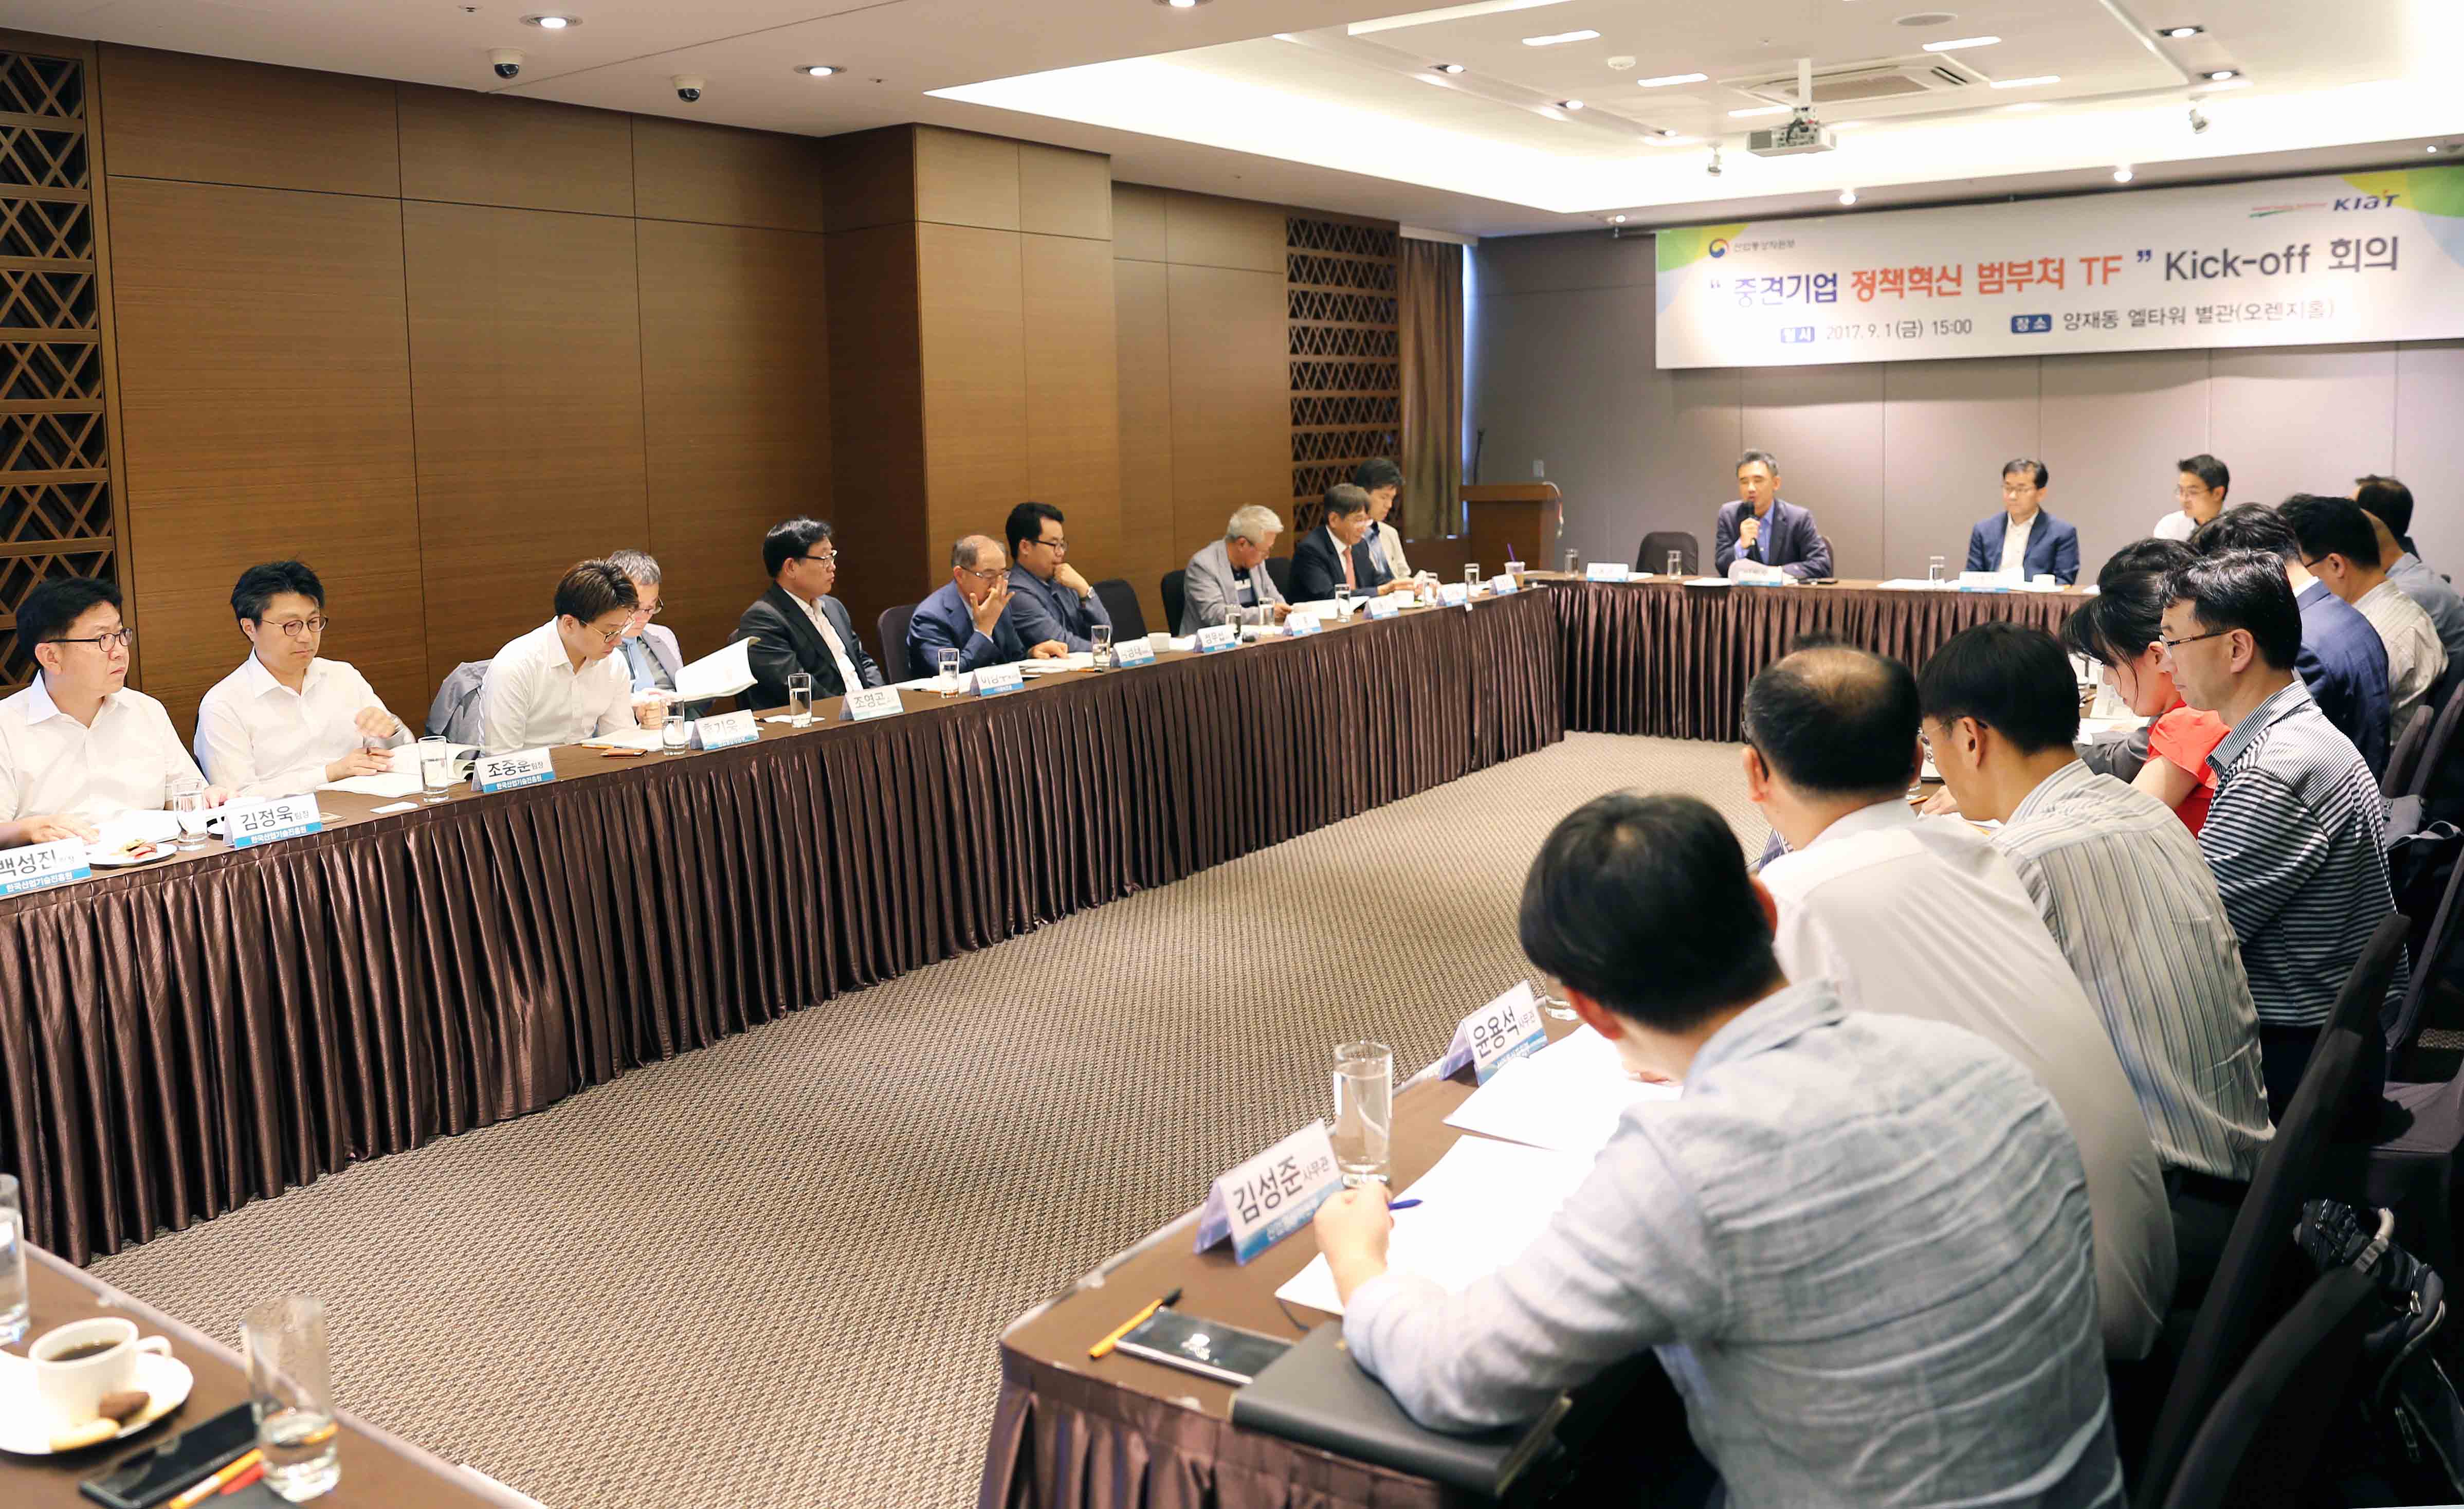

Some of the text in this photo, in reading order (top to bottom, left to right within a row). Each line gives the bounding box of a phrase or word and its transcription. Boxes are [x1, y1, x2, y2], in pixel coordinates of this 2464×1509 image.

[1733, 272, 1837, 308] 중견기업
[1851, 263, 1962, 303] 정책혁신
[1977, 257, 2066, 295] 범부처
[2079, 255, 2123, 286] TF
[2164, 243, 2311, 282] Kick-off
[2328, 235, 2399, 273] 회의
[1931, 318, 1973, 335] 15:00
[2063, 310, 2119, 331] 양재동
[2127, 306, 2186, 328] 엘타워
[487, 759, 531, 777] 조중운
[240, 806, 293, 831] 김정욱
[250, 826, 306, 844] 한국산업기술진흥원
[0, 849, 56, 877] 백성진
[6, 871, 73, 893] 한국산업기술진흥원
[1473, 1005, 1520, 1059] 윤용석
[1233, 1156, 1303, 1224] 김성준
